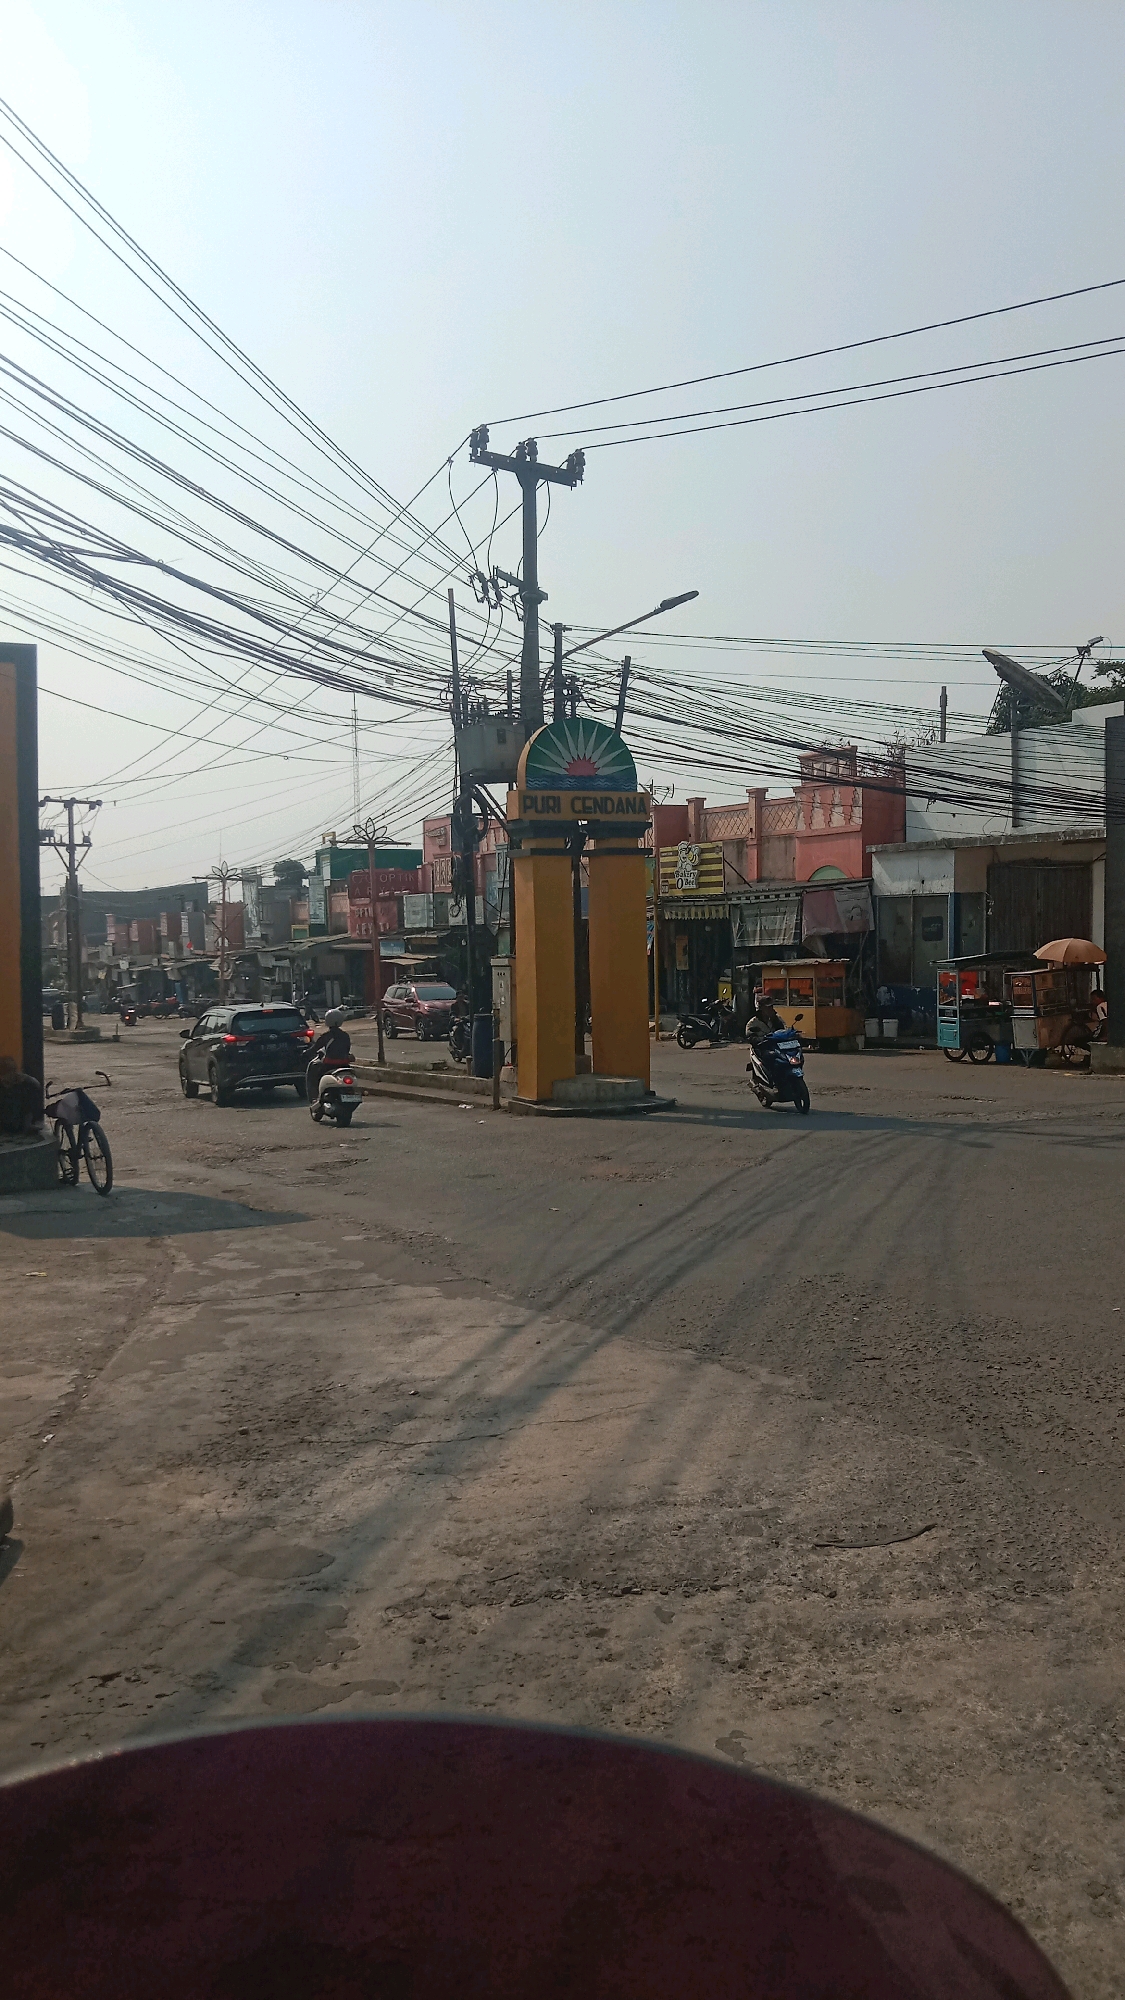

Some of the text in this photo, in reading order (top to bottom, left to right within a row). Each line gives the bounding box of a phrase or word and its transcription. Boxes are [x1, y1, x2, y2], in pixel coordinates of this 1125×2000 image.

[522, 795, 648, 815] PURI CENDANA
[380, 873, 415, 883] OPTIK
[675, 870, 696, 880] Bakery
